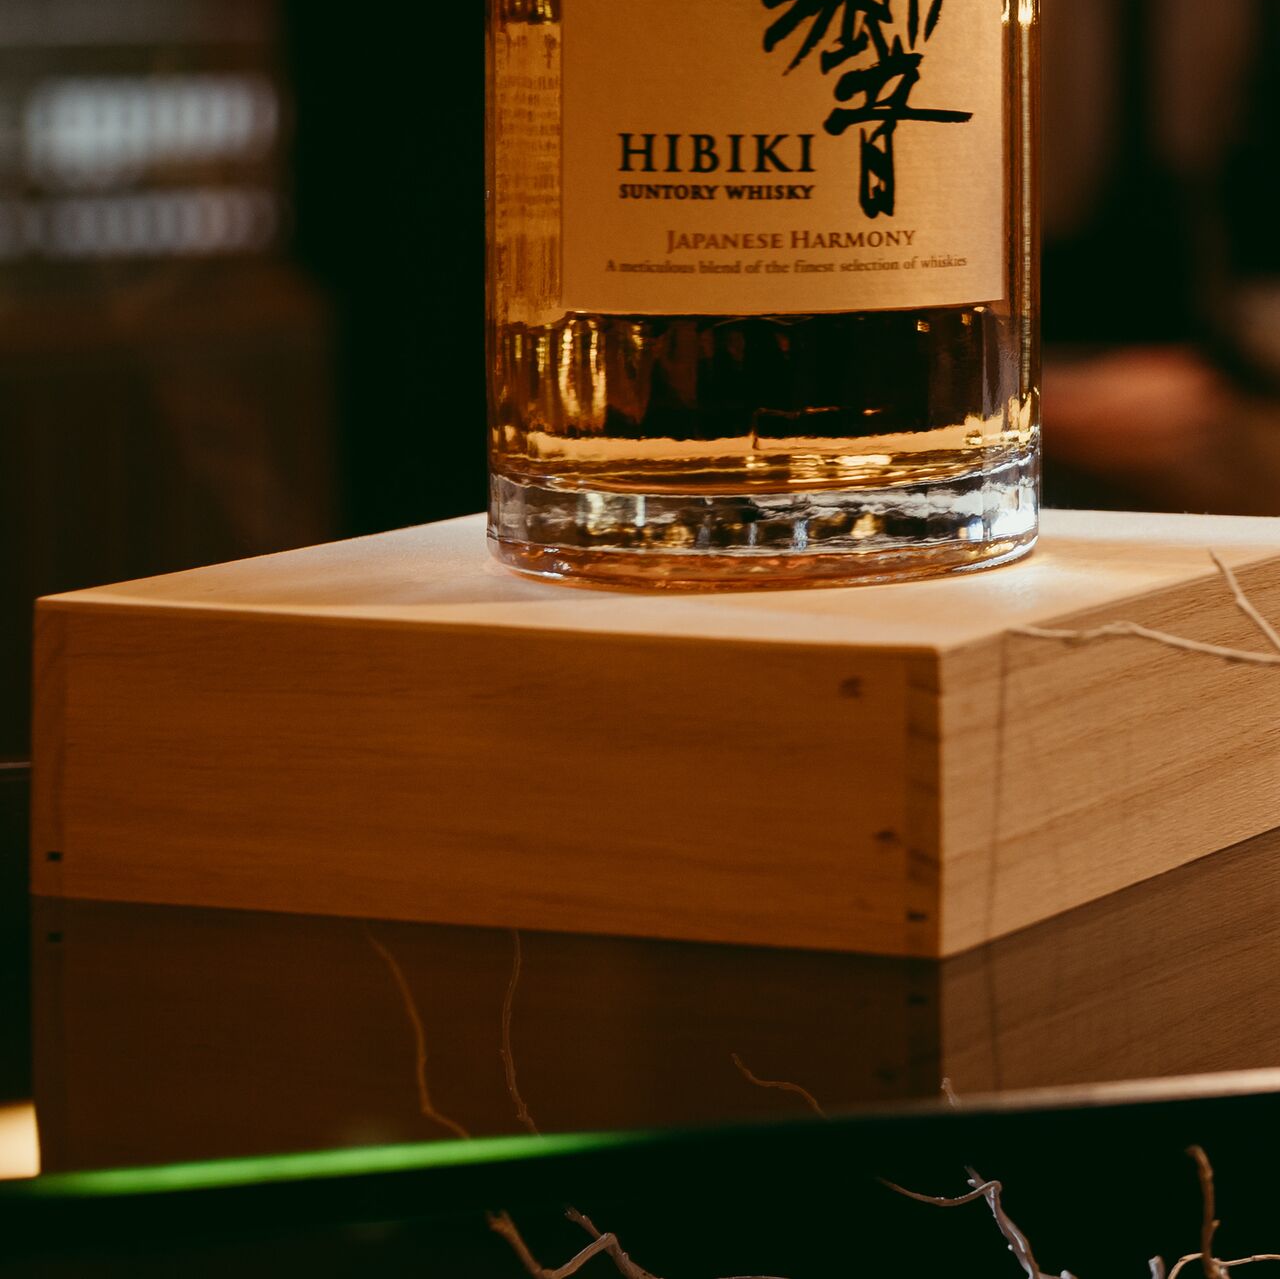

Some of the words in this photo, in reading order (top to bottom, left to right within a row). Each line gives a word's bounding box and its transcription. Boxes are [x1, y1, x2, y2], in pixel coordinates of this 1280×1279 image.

[617, 132, 817, 173] HIBIKI
[618, 184, 718, 201] SUNTORY
[724, 184, 814, 201] WHISKY
[666, 230, 783, 254] JAPANESE
[790, 230, 916, 250] HARMONY
[607, 260, 616, 272] A
[699, 260, 741, 273] blend
[745, 260, 762, 273] of
[765, 260, 790, 273] the
[794, 259, 834, 273] finest
[840, 258, 898, 272] selection
[903, 256, 918, 270] of
[920, 254, 967, 269] whiskies
